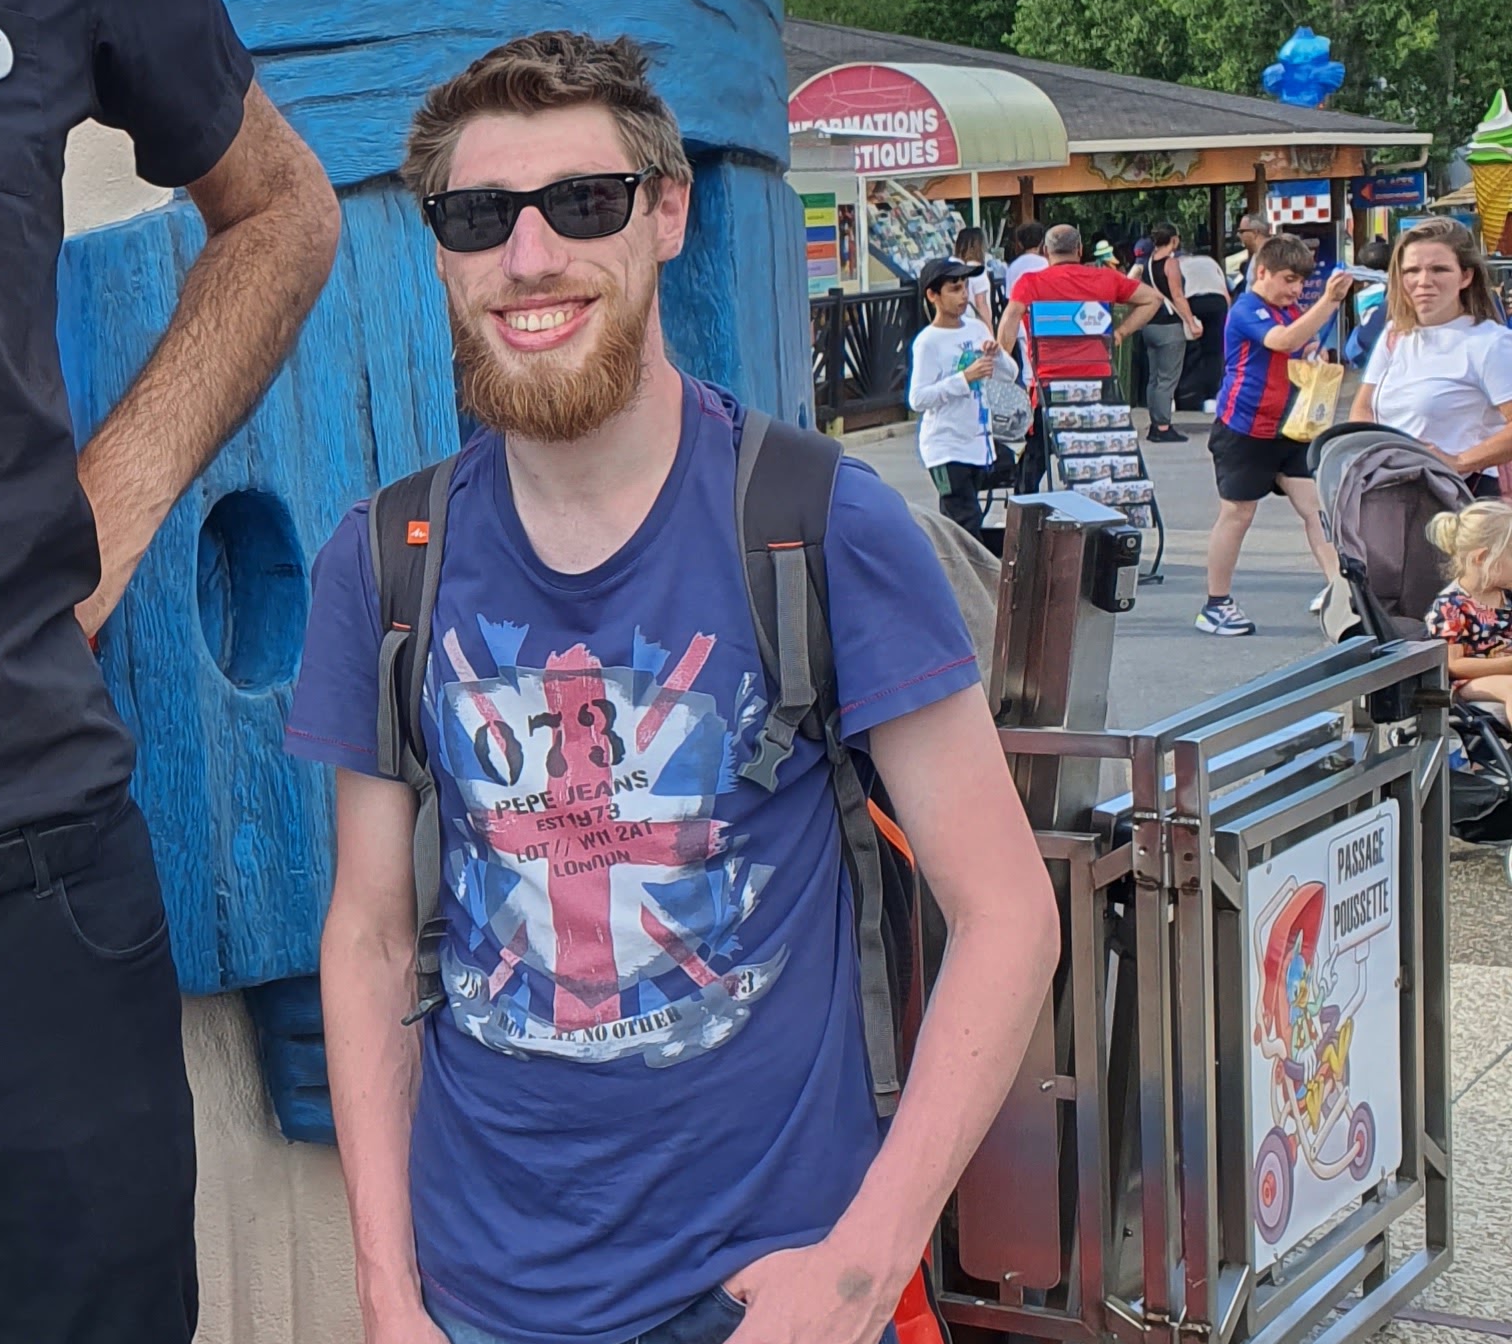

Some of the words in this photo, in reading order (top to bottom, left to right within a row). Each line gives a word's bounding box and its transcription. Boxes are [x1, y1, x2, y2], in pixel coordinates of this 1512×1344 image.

[495, 790, 557, 819] PEPE
[565, 769, 649, 805] JEANS
[1336, 826, 1385, 886] PASSAGE
[1333, 876, 1390, 942] POUSSETTE
[612, 1006, 683, 1040] OTHER
